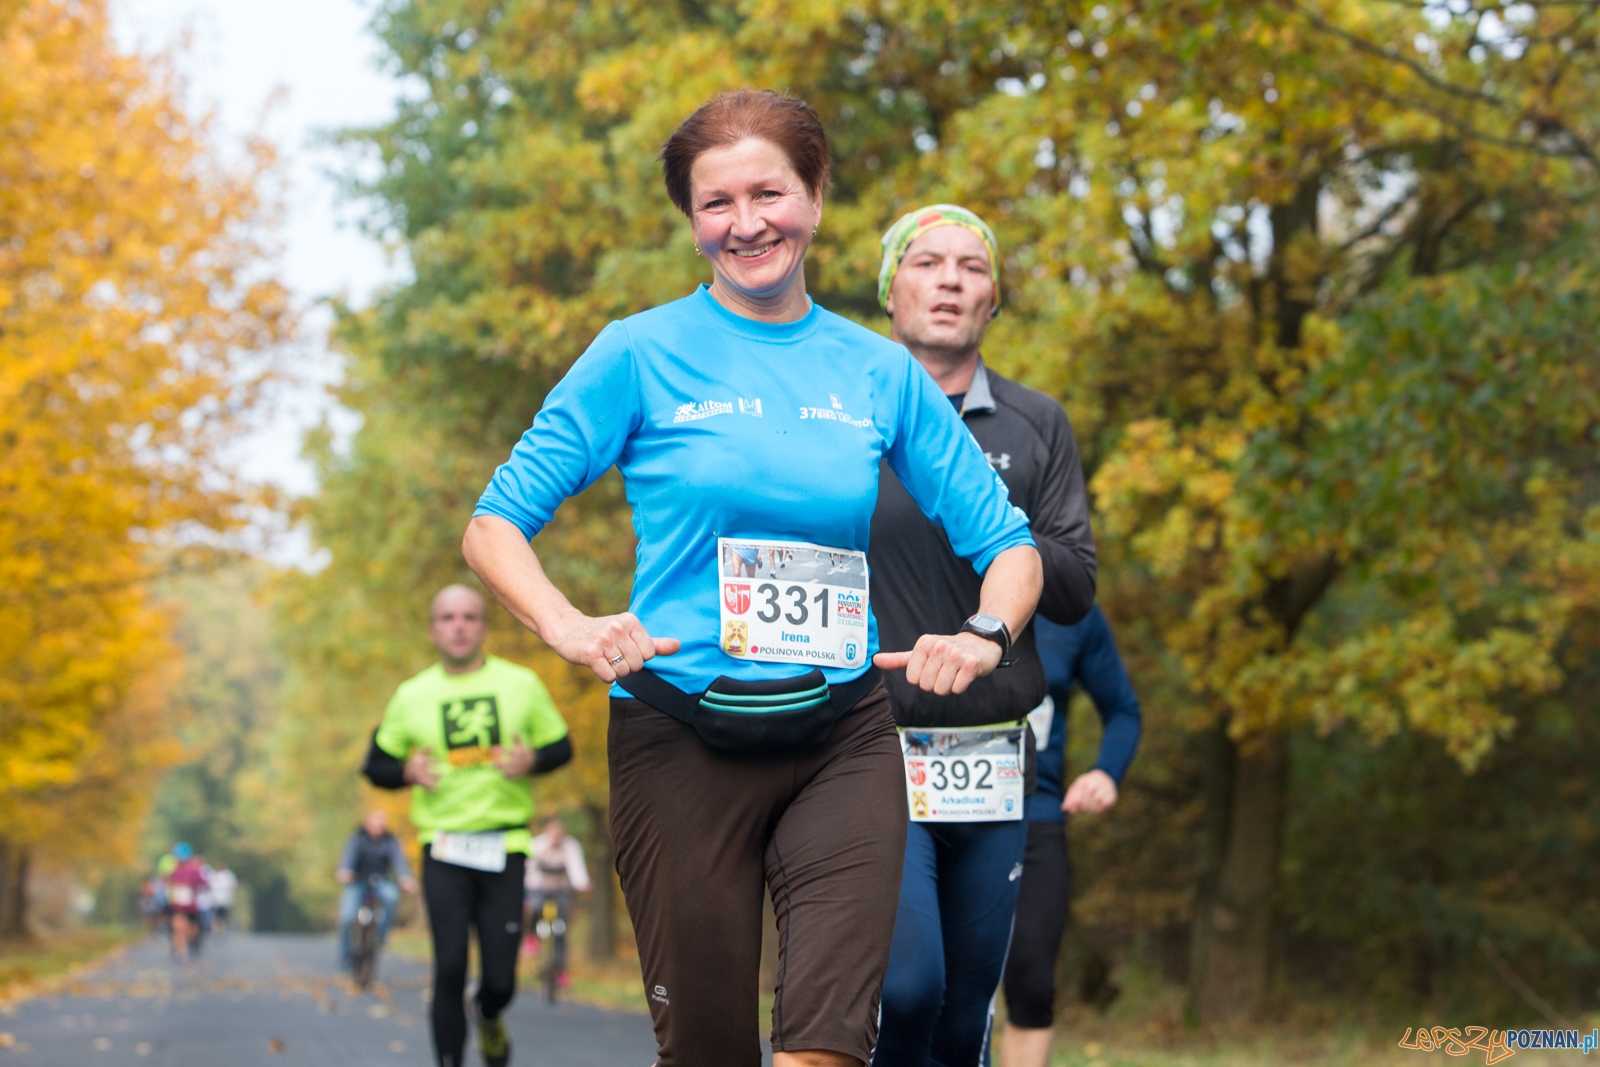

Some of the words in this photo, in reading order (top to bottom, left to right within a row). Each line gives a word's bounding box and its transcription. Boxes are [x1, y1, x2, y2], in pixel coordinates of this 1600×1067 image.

[800, 407, 817, 419] 37
[757, 583, 829, 628] 331
[838, 600, 862, 609] MARATON
[781, 631, 810, 643] Irena
[760, 646, 804, 657] POLINOVA
[805, 650, 835, 660] POLSKA
[931, 759, 993, 791] 392
[941, 796, 985, 804] Arkadiusz
